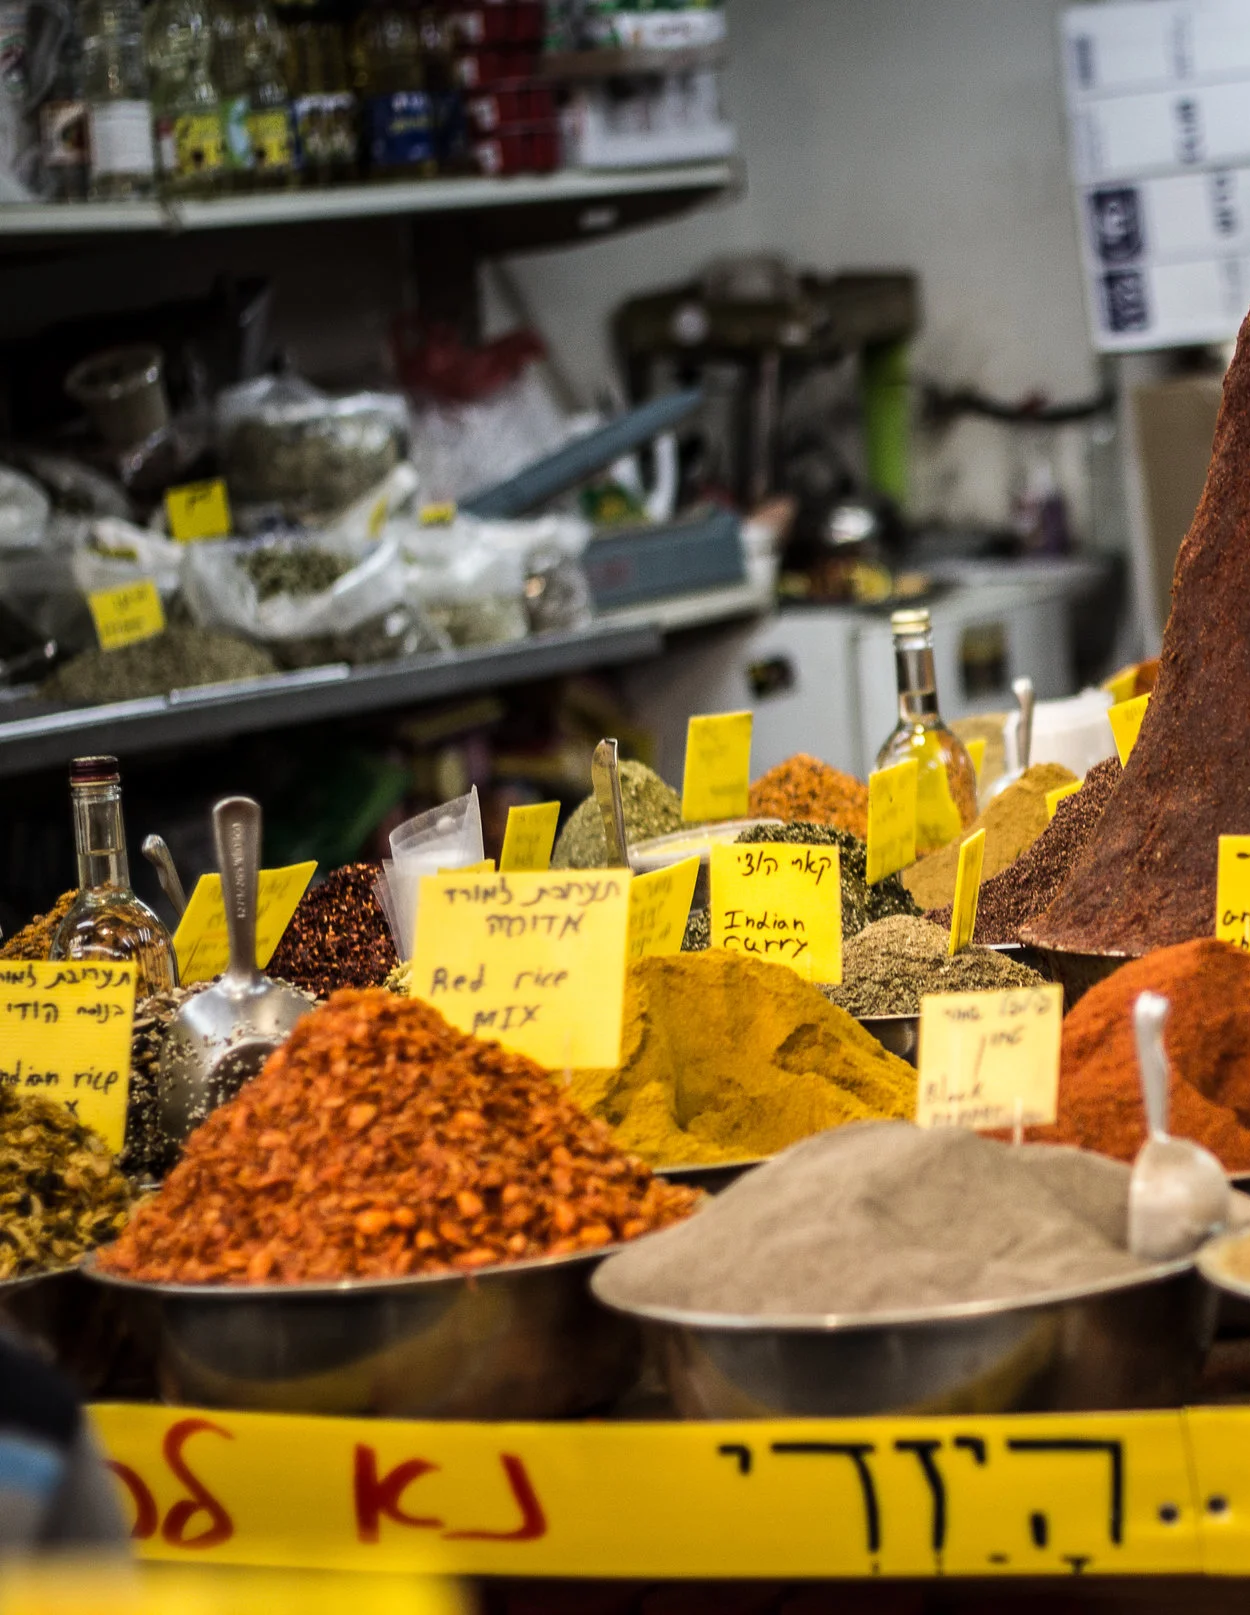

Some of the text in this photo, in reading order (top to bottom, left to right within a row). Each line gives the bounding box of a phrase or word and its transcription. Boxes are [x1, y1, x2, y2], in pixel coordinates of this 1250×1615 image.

[724, 909, 805, 931] Indian
[430, 963, 569, 997] Red rice
[351, 1442, 549, 1546] נא
